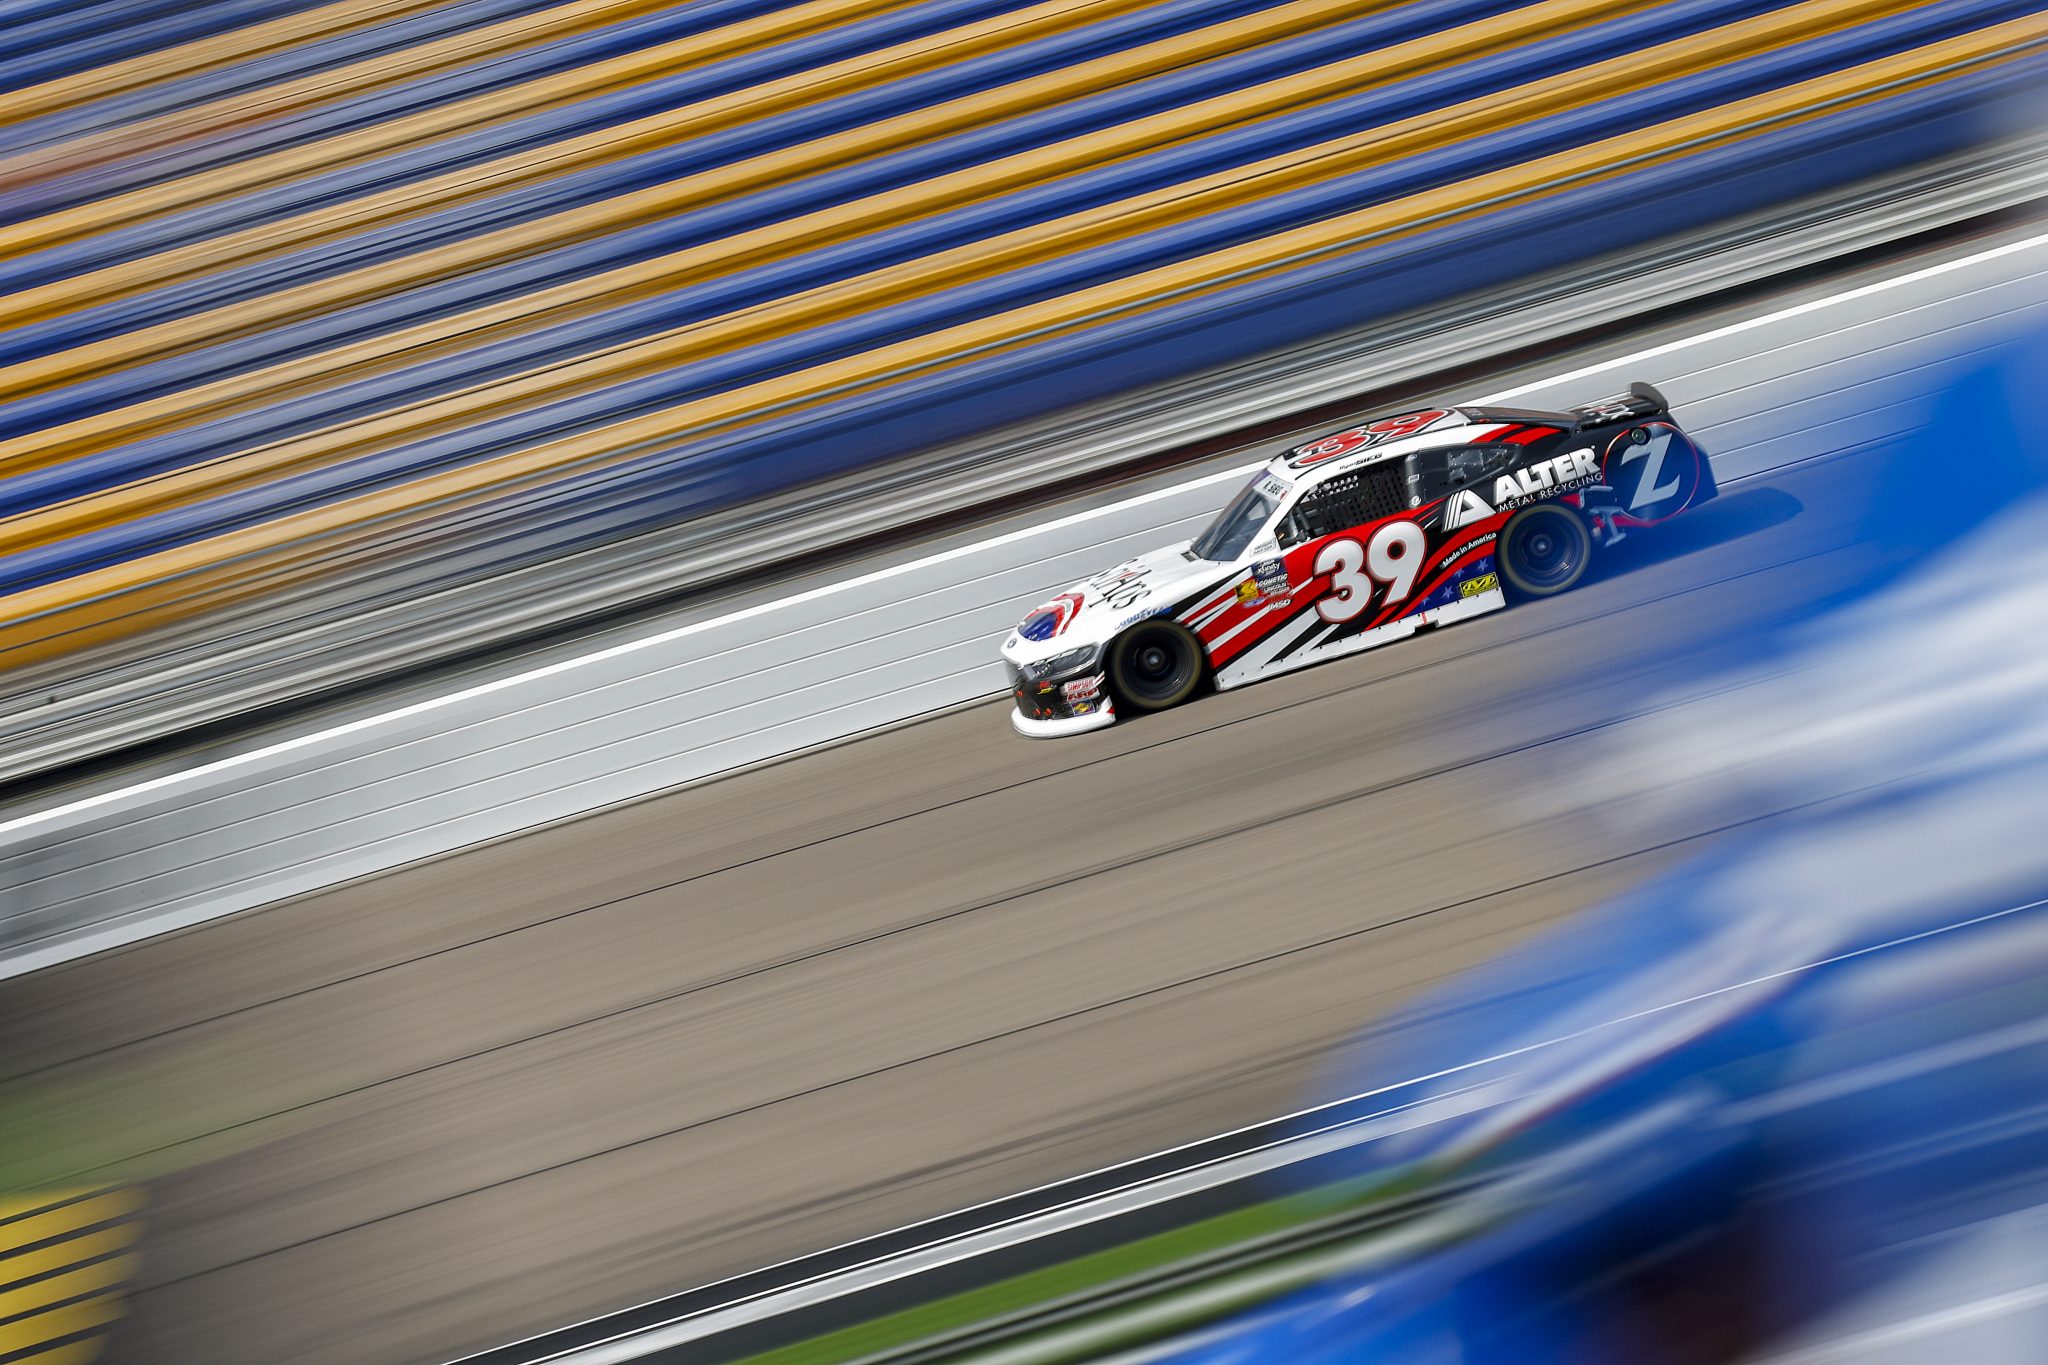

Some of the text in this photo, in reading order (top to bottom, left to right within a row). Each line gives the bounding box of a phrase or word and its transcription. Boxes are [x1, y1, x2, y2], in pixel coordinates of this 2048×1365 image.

[1288, 408, 1455, 468] 39
[1494, 447, 1601, 506] ALTER
[1498, 470, 1603, 513] METAL RECYCLING
[1619, 433, 1681, 511] Z
[1257, 561, 1281, 574] xfinity
[1312, 518, 1427, 624] 39
[1442, 532, 1497, 567] Made in America
[1269, 599, 1291, 611] MSD
[1067, 679, 1095, 692] SIMPSON
